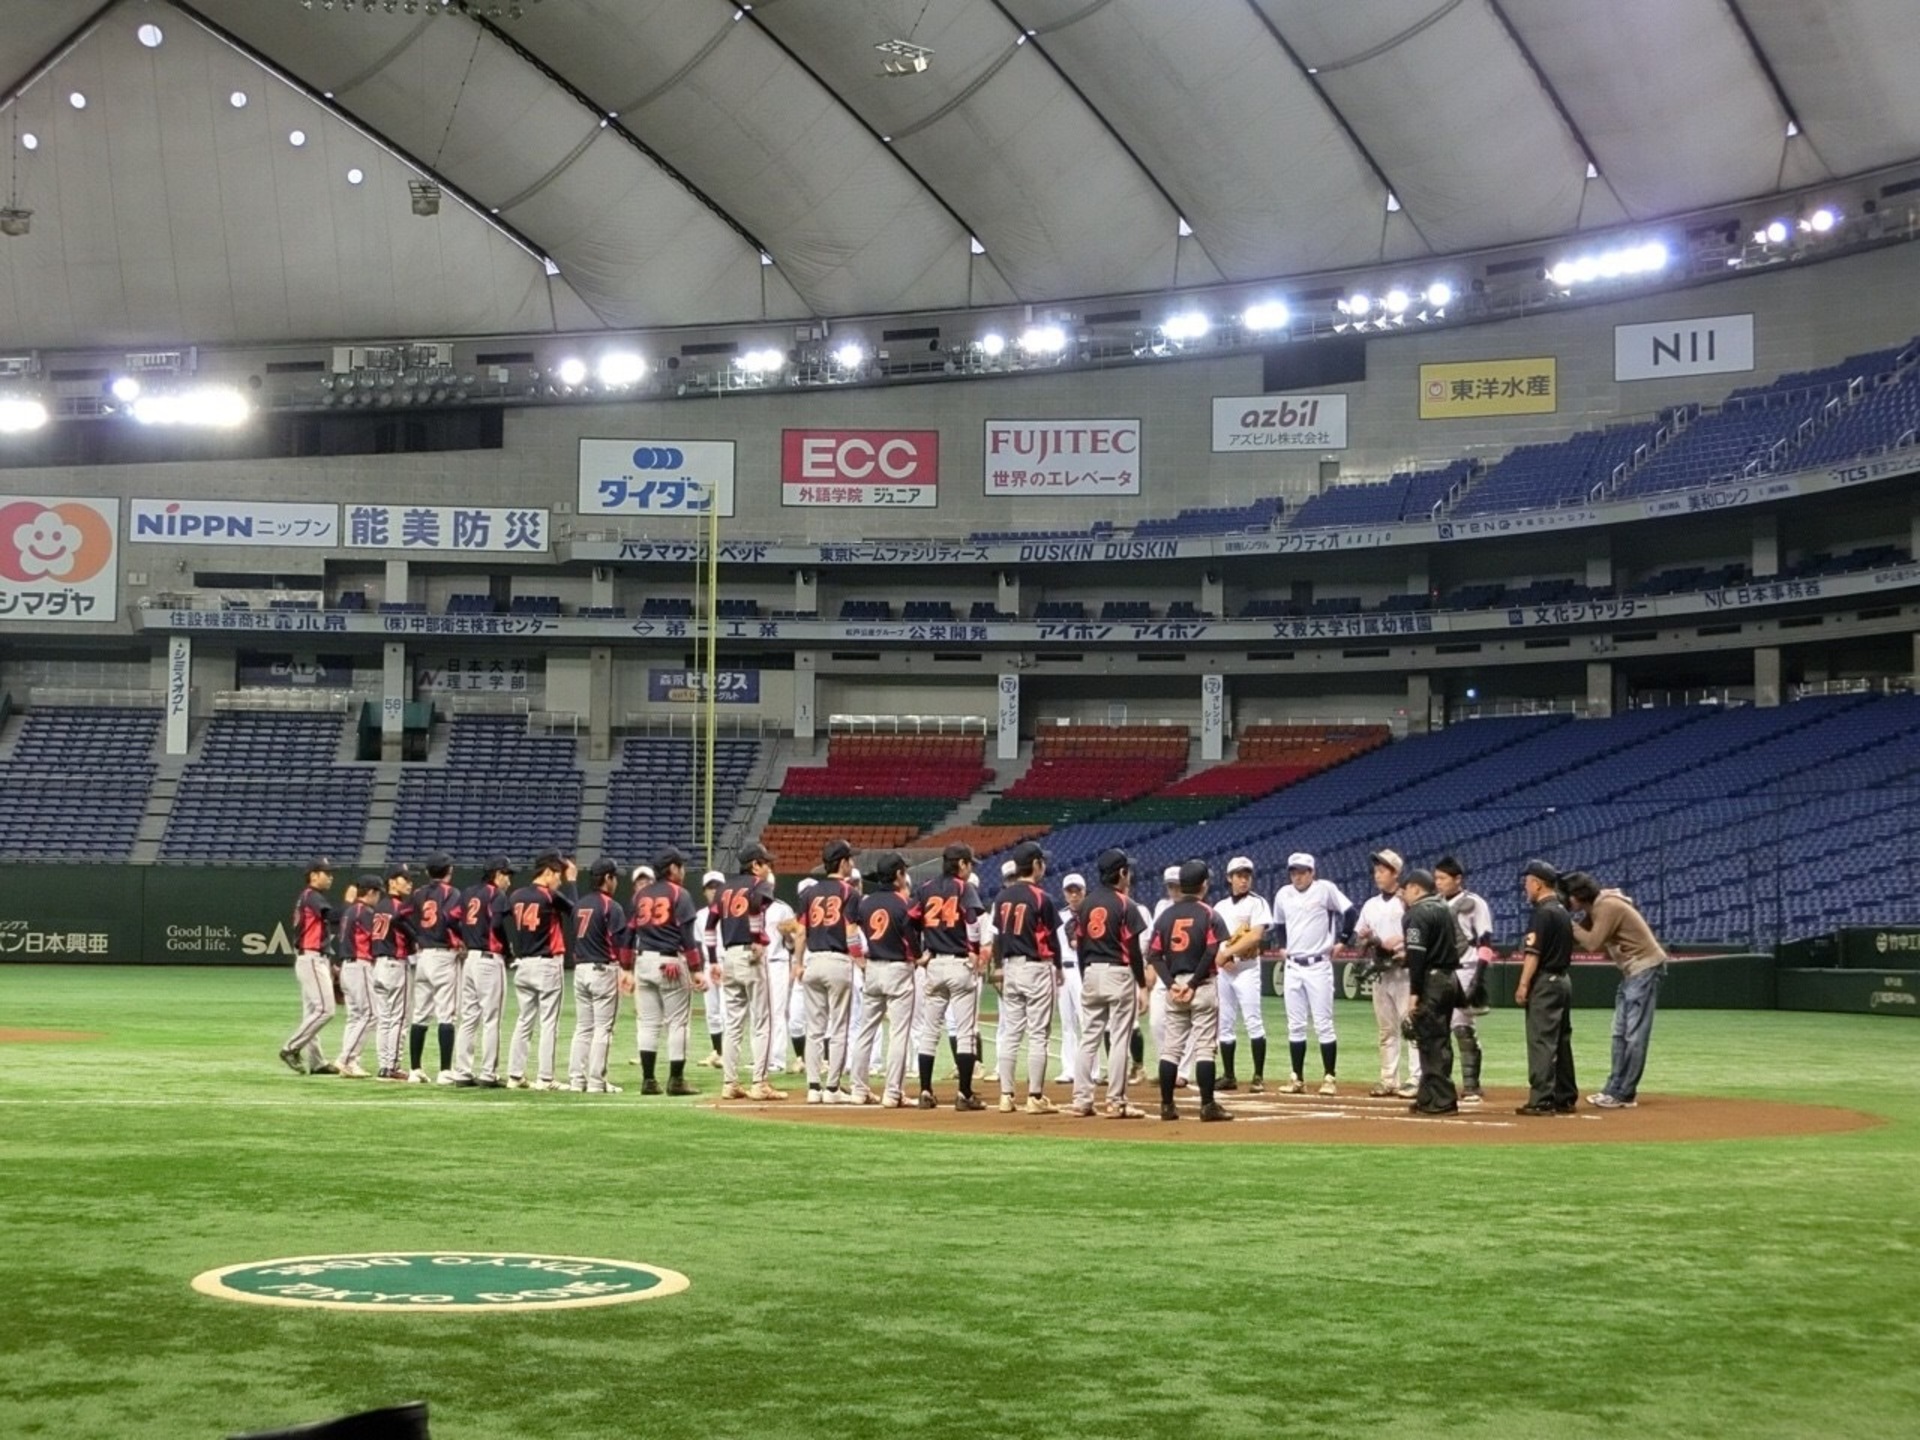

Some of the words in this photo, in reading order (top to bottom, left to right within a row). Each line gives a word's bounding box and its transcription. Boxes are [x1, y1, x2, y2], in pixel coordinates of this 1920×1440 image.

[1653, 330, 1715, 366] NII
[1450, 375, 1551, 401] 東洋水産
[1240, 400, 1319, 428] azbil
[991, 429, 1136, 465] FUJITEC
[1228, 431, 1331, 447] アズビル株式会社
[802, 438, 917, 478] ECC
[993, 470, 1132, 488] 世界のエレベータ
[1838, 466, 1868, 483] TCS
[598, 475, 714, 509] ダイダン
[799, 487, 863, 504] 外語学院
[873, 488, 921, 504] ジュニア
[1688, 488, 1749, 511] 美和ロック
[257, 519, 331, 537] ニップン
[351, 508, 542, 549] 能美防災
[820, 546, 989, 562] 東京ドームファシリティーズ
[1275, 533, 1340, 552] アクティオ
[0, 588, 95, 616] シマダヤ
[1737, 580, 1822, 604] 日本事務器
[297, 614, 347, 631] 小泉
[665, 620, 779, 637] 第一工業
[909, 625, 988, 640] 公栄開発
[1036, 624, 1113, 640] アイホン
[1134, 623, 1208, 640] アイホン
[1273, 616, 1433, 639] 文教大学付属幼稚園
[447, 658, 525, 673] 日本大学
[446, 675, 525, 690] 理工学部
[420, 900, 439, 929] 3
[466, 897, 479, 925] 2
[635, 896, 672, 926] 33
[721, 887, 749, 918] 16
[809, 895, 842, 926] 63
[925, 895, 961, 928] 24
[513, 902, 541, 932] 14
[576, 908, 594, 938] 7
[868, 911, 890, 941] 9
[999, 901, 1025, 935] 11
[1087, 906, 1108, 939] 8
[166, 925, 202, 938] Good
[205, 925, 237, 938] luck.
[166, 938, 202, 951] Good
[205, 938, 231, 951] life.
[1170, 917, 1193, 953] 5
[257, 1282, 455, 1303] TOKYO
